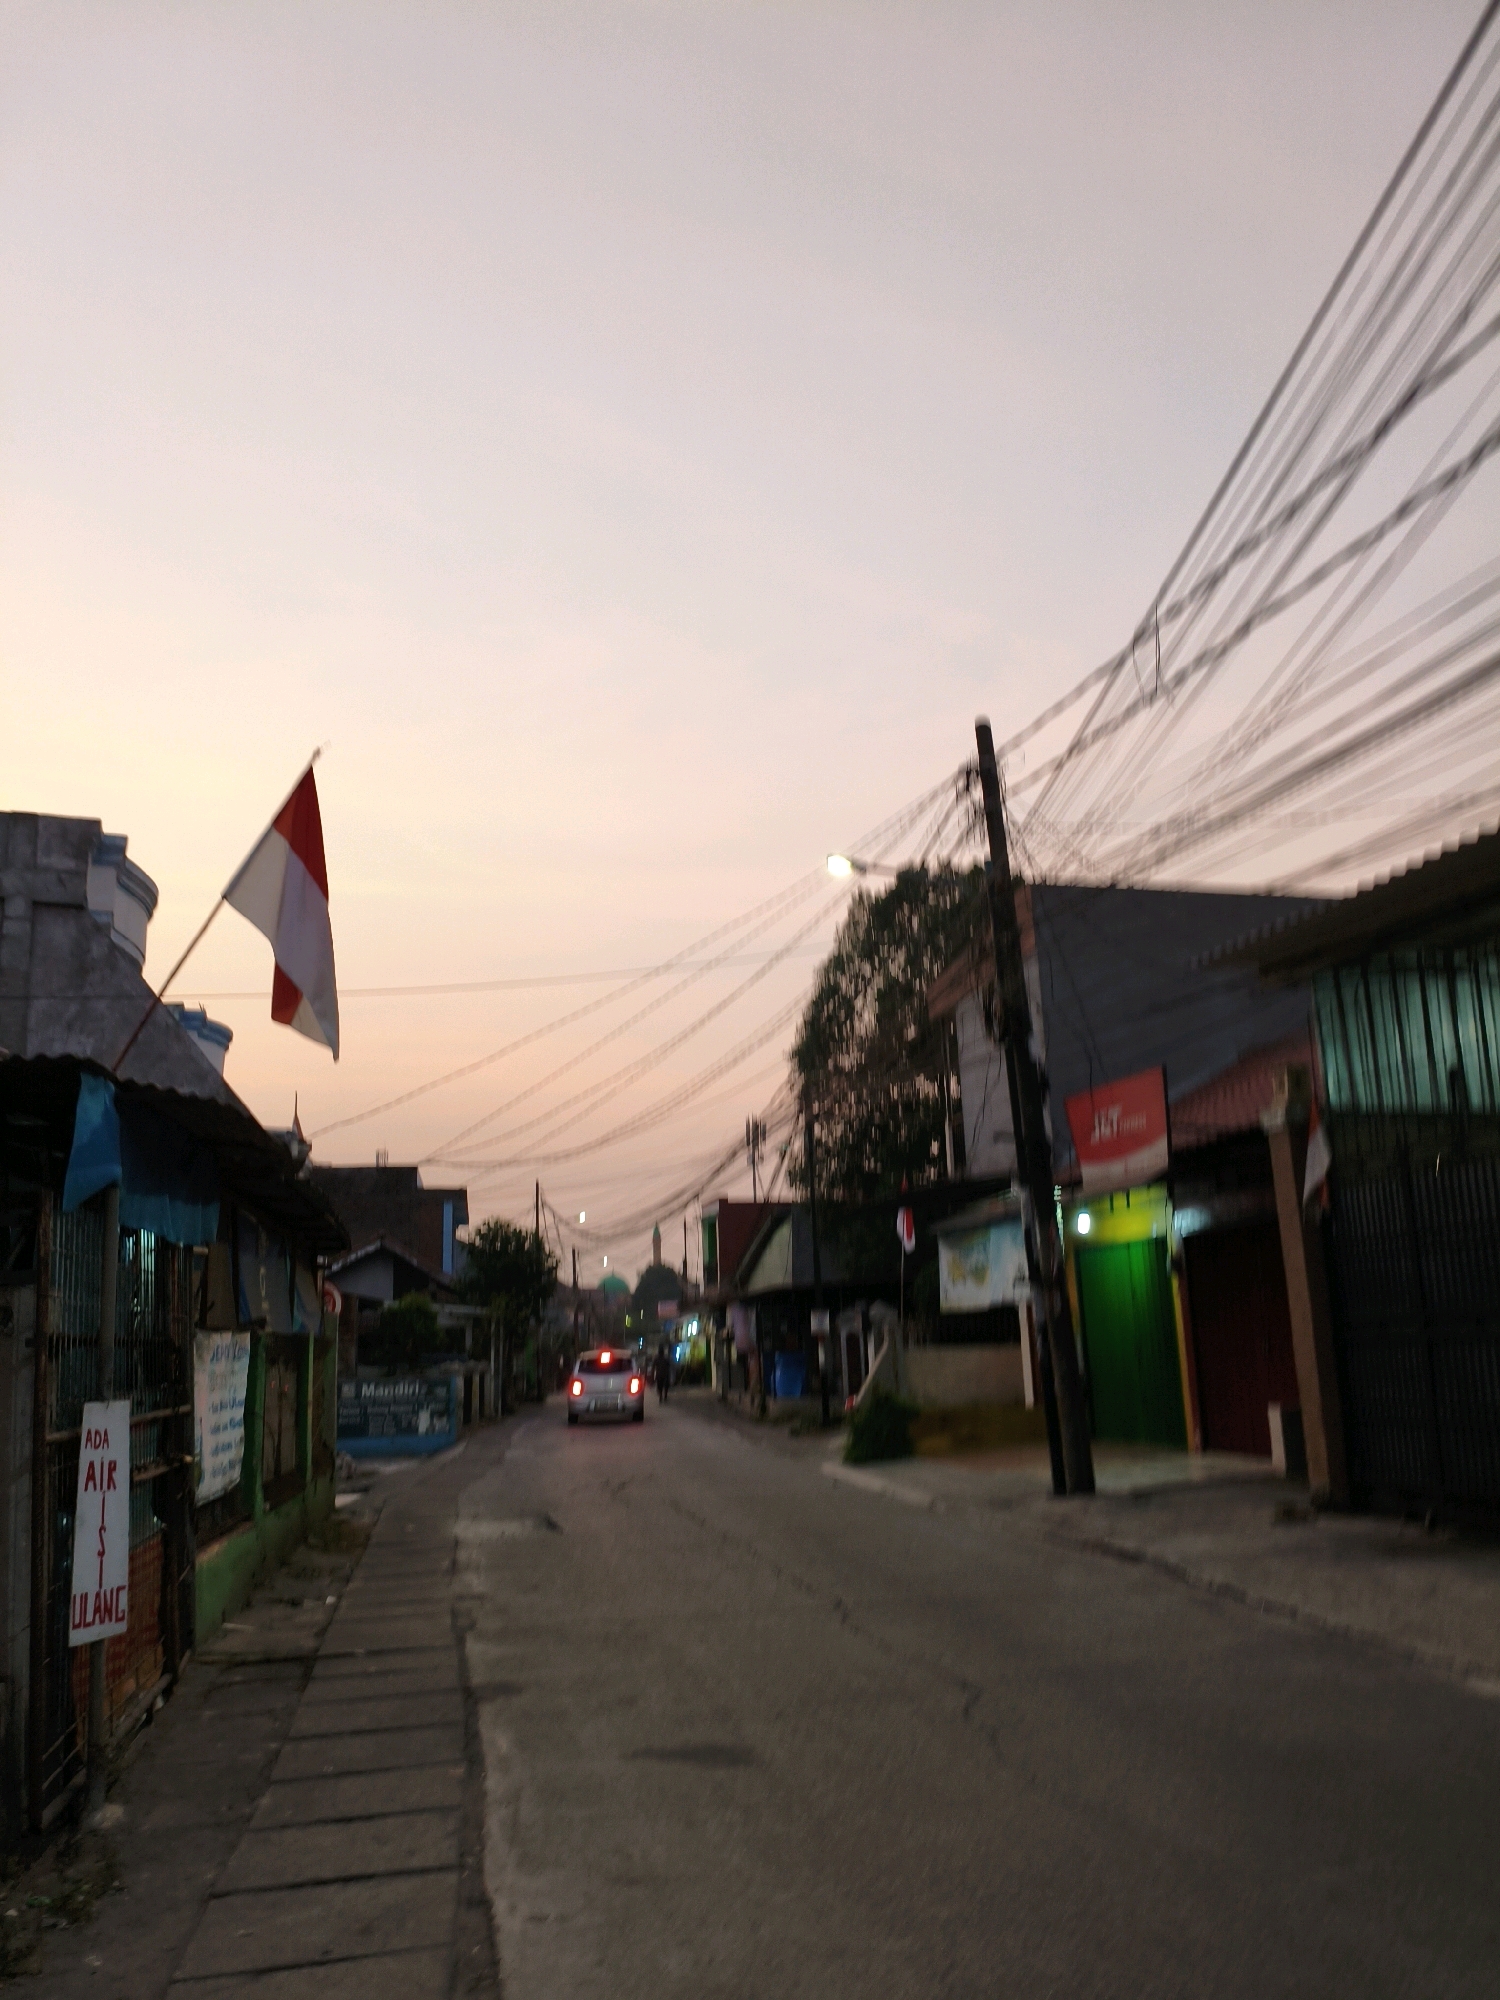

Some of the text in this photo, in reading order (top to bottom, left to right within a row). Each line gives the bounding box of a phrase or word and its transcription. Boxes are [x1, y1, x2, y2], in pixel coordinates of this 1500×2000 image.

[85, 1428, 109, 1450] ADA
[84, 1457, 117, 1492] AIR
[71, 1585, 126, 1631] ULANG
